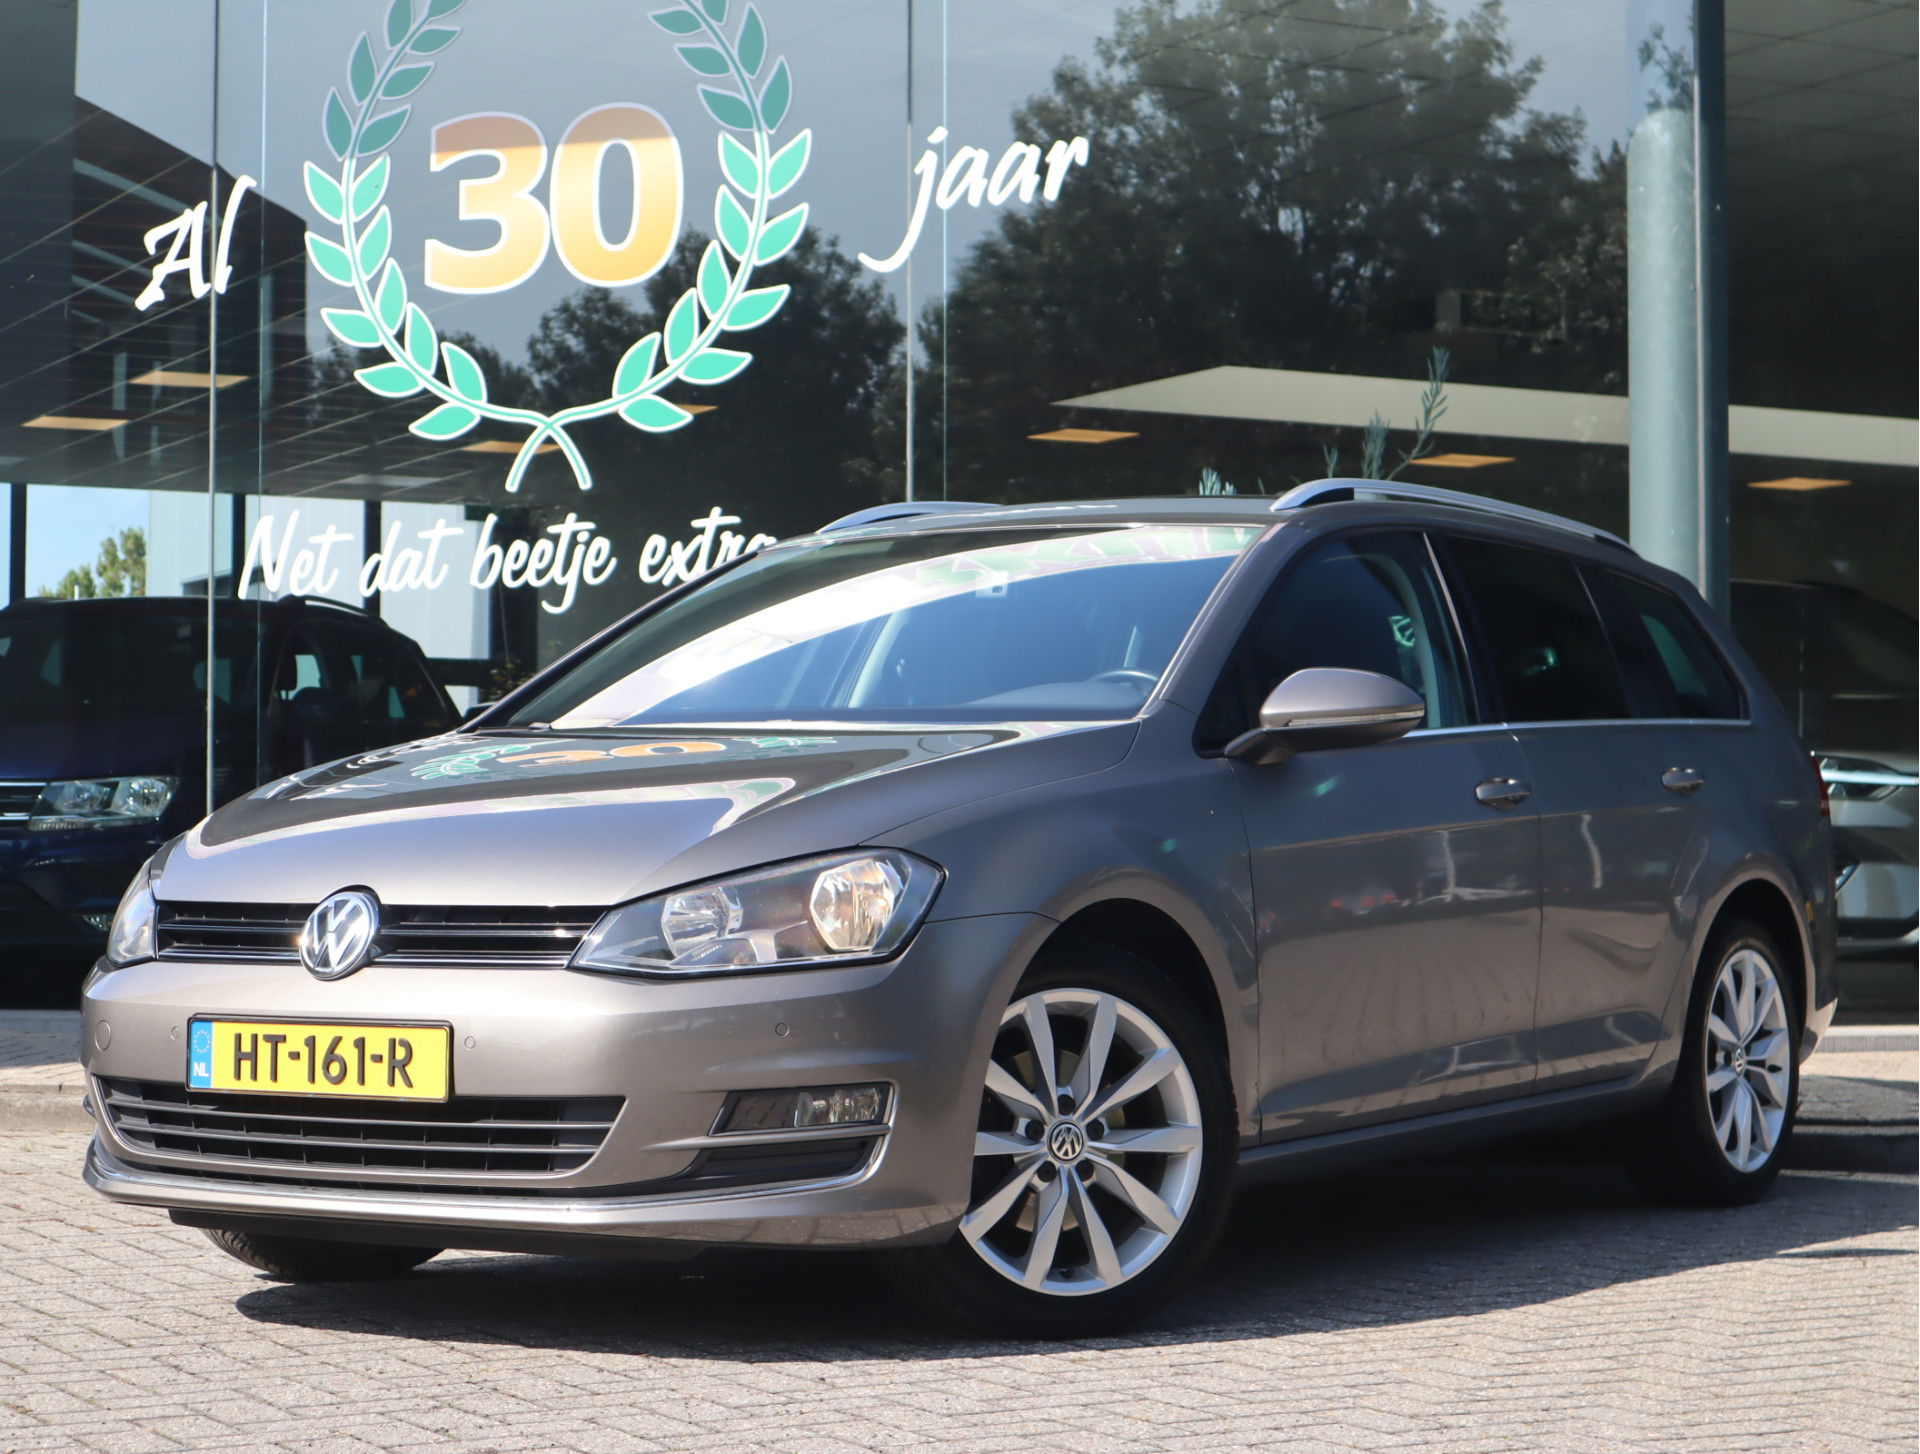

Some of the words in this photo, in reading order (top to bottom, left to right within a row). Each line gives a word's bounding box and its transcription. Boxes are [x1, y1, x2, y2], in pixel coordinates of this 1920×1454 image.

[134, 174, 258, 312] Al
[423, 101, 685, 295] 30
[857, 125, 1090, 273] jaar
[237, 510, 354, 600] Net
[359, 518, 465, 598] dat
[469, 512, 618, 614] beetje
[193, 1062, 209, 1078] NL
[233, 1032, 414, 1089] HT-161-R
